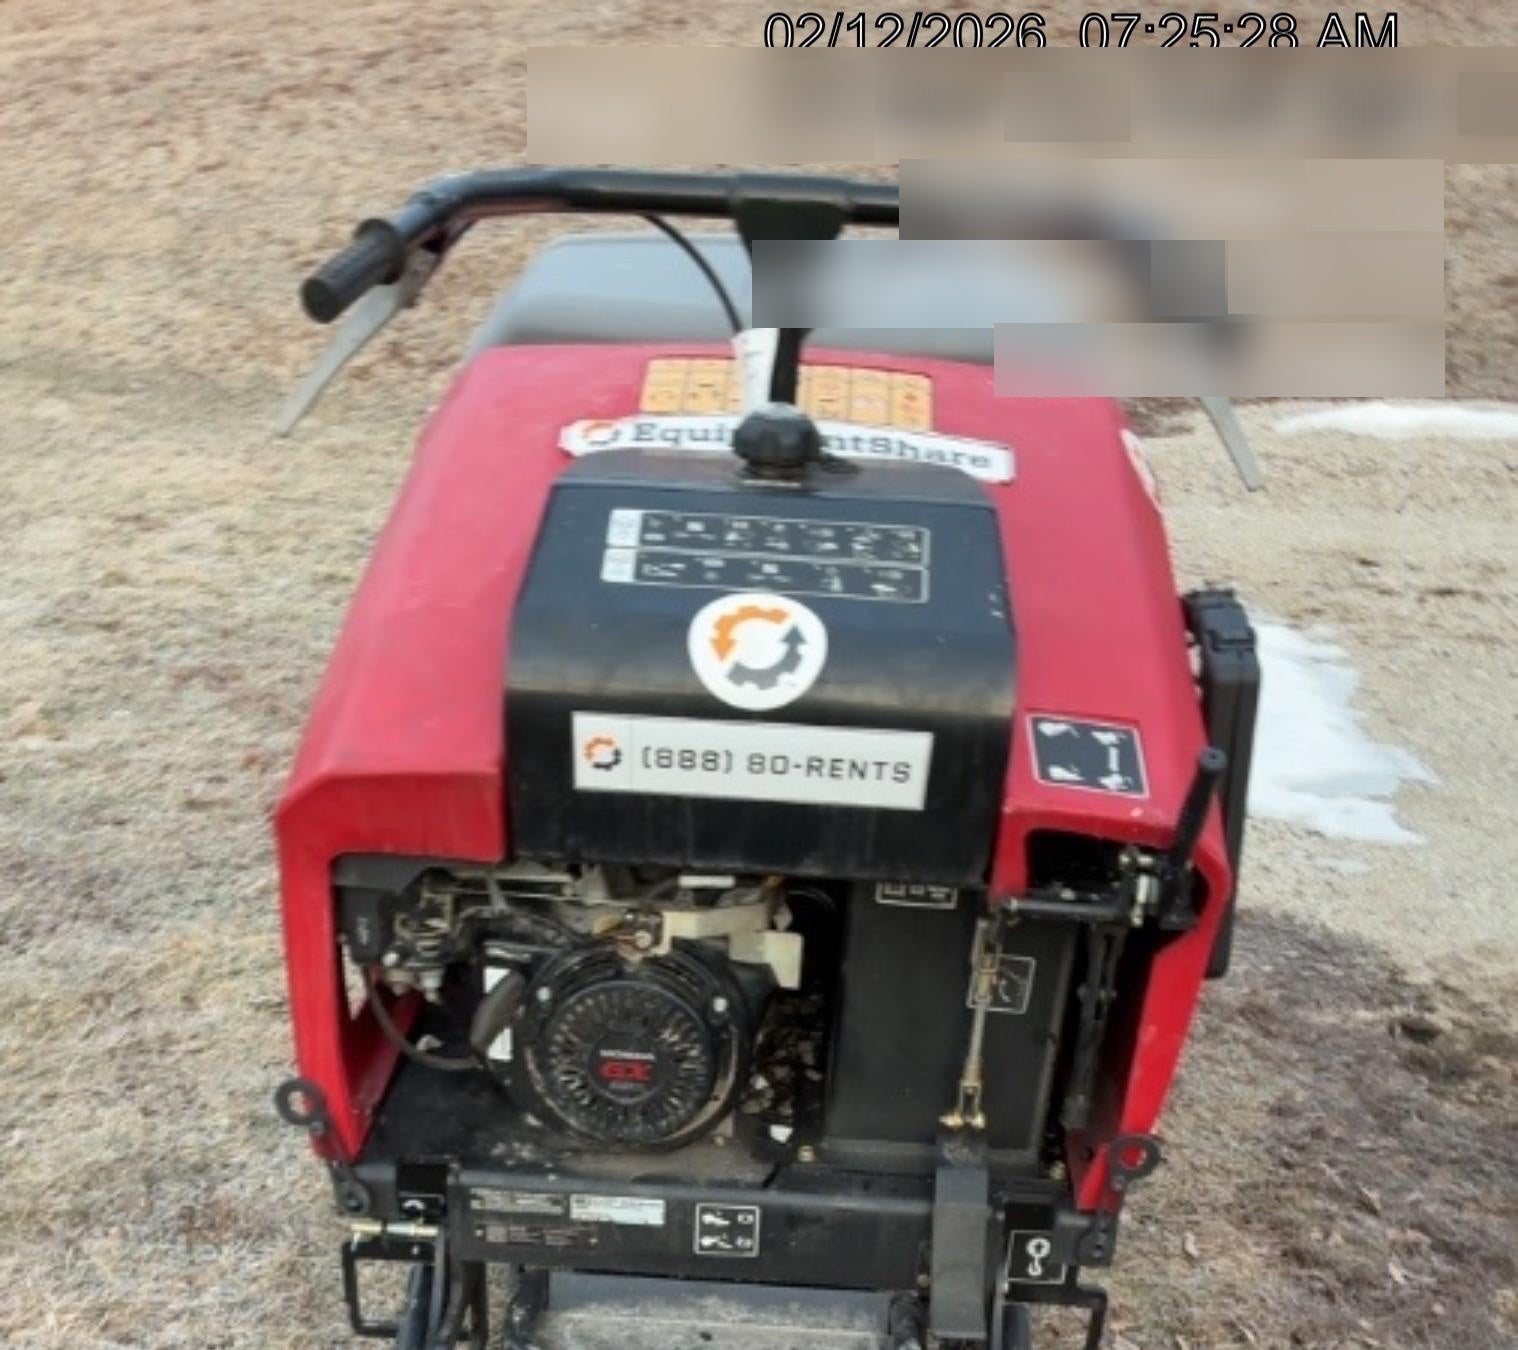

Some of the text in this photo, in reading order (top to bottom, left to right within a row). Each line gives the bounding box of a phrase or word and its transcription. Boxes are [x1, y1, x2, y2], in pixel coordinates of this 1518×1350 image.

[631, 422, 992, 469] EquintShare
[642, 746, 913, 783] (888) 80-RENTS
